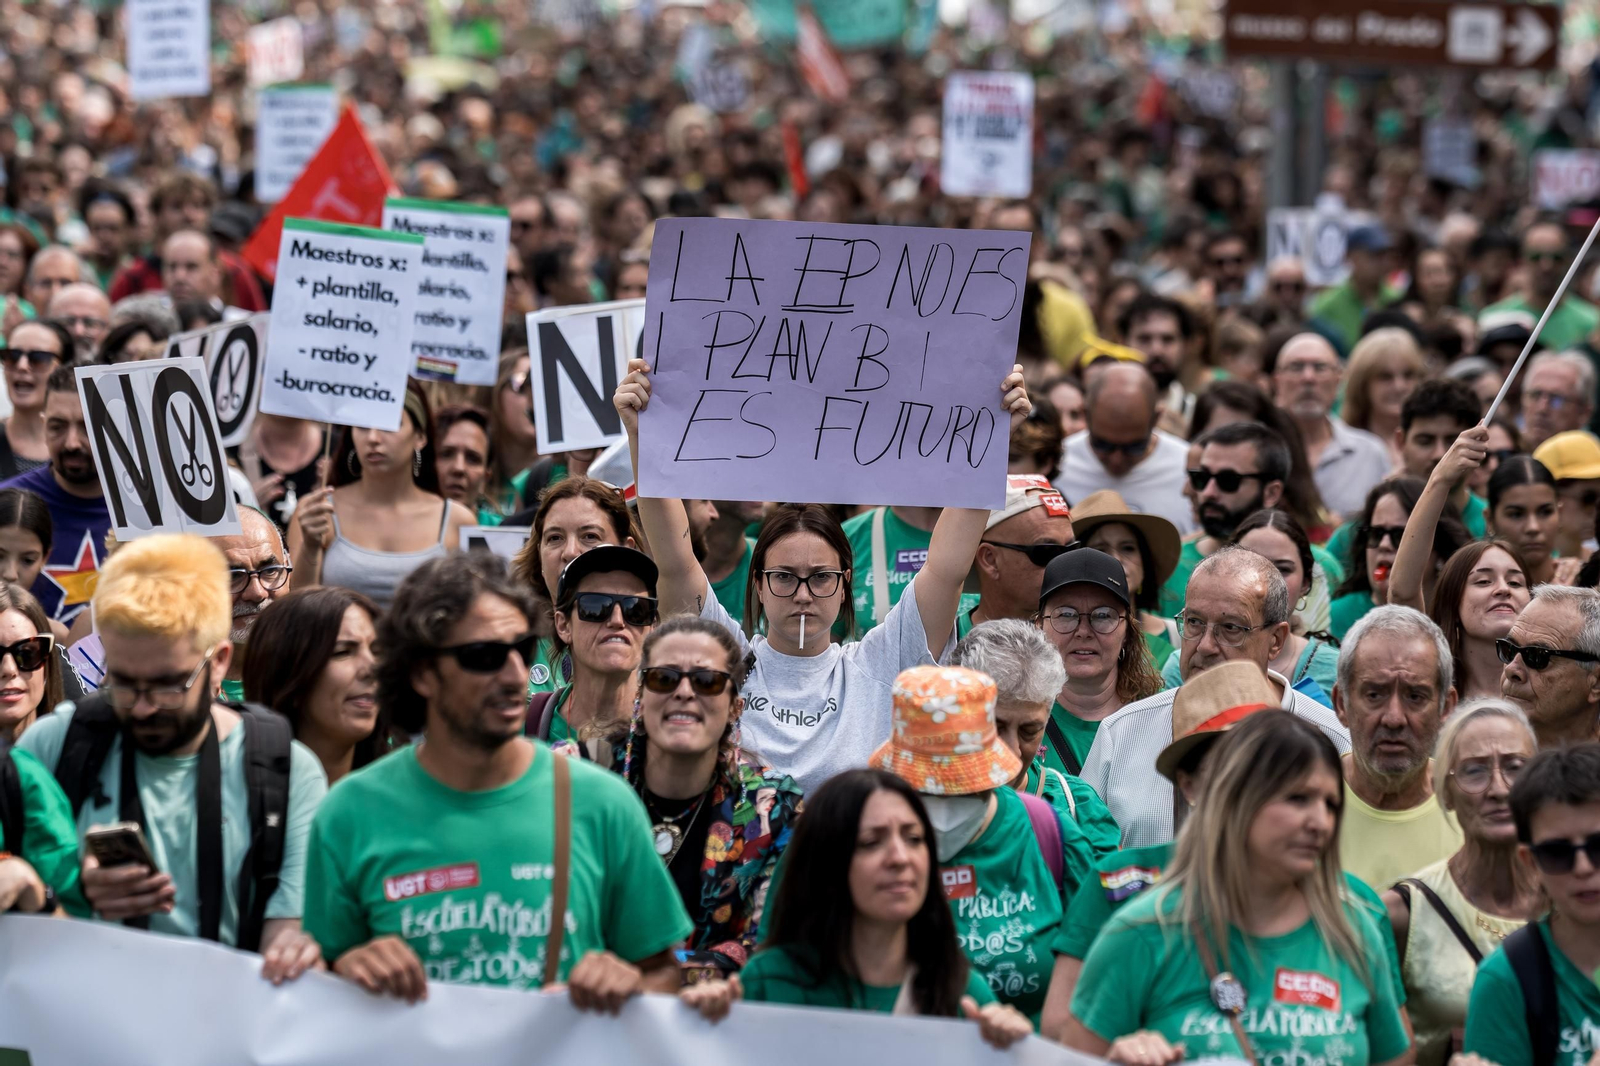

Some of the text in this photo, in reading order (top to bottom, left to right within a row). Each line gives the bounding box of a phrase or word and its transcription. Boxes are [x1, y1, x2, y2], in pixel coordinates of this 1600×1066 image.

[290, 239, 408, 272] Maestros x:
[669, 230, 765, 306] LA
[793, 233, 881, 309] EP
[296, 276, 400, 307] + plantilla,
[303, 309, 379, 338] salario,
[310, 345, 360, 365] ratio
[364, 353, 378, 372] y
[701, 310, 834, 384] PLAN
[844, 322, 891, 392] B
[274, 370, 396, 403] -burocracia.
[674, 388, 996, 469] ES FUTURO
[81, 366, 227, 528] NO
[386, 873, 426, 899] UGT
